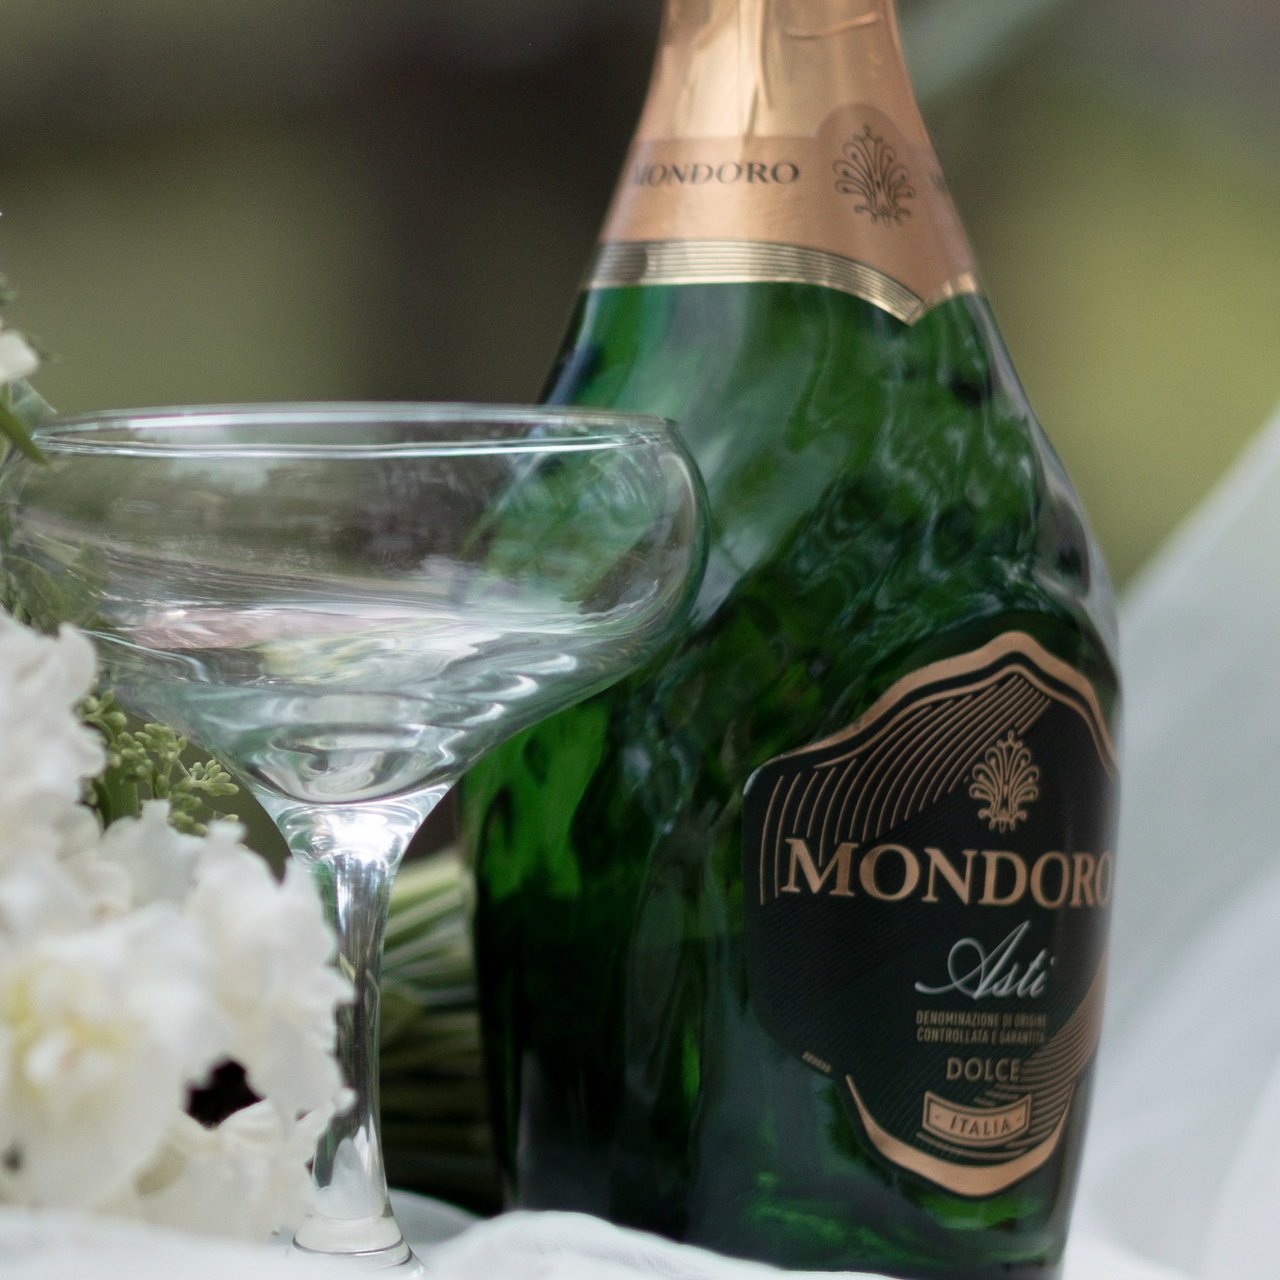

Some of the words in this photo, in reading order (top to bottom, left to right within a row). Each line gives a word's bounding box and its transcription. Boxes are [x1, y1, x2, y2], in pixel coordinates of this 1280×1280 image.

[781, 837, 1116, 910] MONDORO
[914, 920, 1055, 1000] Asti
[916, 1010, 1000, 1026] DENOMINAZIONE
[916, 1026, 989, 1044] CONTROLLATA
[946, 1056, 1021, 1083] DOLCE
[949, 1117, 1011, 1136] ITALIA
